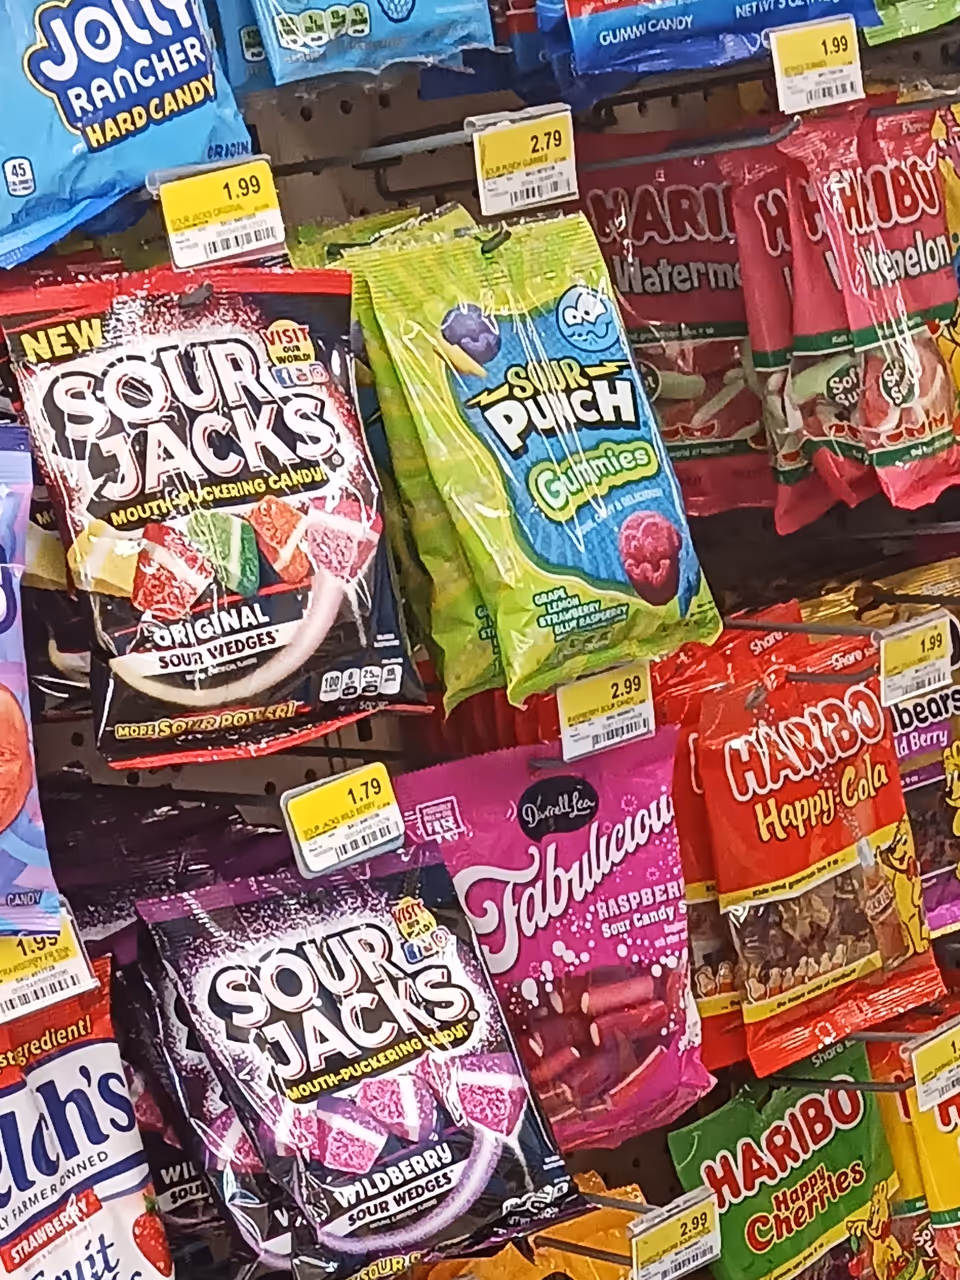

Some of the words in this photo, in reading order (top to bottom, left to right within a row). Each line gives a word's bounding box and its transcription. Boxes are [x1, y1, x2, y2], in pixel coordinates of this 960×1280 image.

[40, 0, 194, 82] JOLLY
[648, 14, 694, 33] CANDY
[821, 34, 849, 56] 1.99
[66, 36, 207, 118] RANCHER
[85, 107, 148, 148] HARD
[149, 73, 216, 120] CANDY
[530, 129, 562, 155] 2.79
[11, 163, 27, 178] 45
[222, 174, 262, 201] 1.99
[21, 318, 104, 363] NEW
[263, 325, 310, 346] VISIT
[53, 341, 271, 441] SOUR
[506, 359, 591, 399] SOUR
[486, 379, 639, 453] PUNCH
[100, 396, 338, 501] JACKS
[537, 448, 650, 511] Gummies
[110, 478, 267, 528] MOUTH-PUCKERING
[534, 587, 567, 605] GRAPE
[538, 601, 601, 628] STRAWBERRY
[546, 595, 579, 613] LEMON
[152, 604, 270, 647] ORIGINAL
[920, 635, 944, 654] 1.99
[157, 649, 205, 670] SOUR
[210, 631, 278, 661] WEDGES
[833, 646, 862, 671] Share
[323, 675, 341, 690] 100
[610, 675, 641, 700] 2.99
[115, 722, 155, 740] MORE
[724, 684, 885, 801] HARIBO
[909, 730, 949, 752] Berry
[346, 778, 382, 806] 1.79
[755, 784, 836, 843] Happy
[839, 754, 890, 809] Cola
[7, 892, 42, 907] CANDY
[601, 919, 631, 938] Sour
[633, 904, 675, 928] Candy
[215, 925, 401, 1030] SOUR
[256, 968, 468, 1081] JACKS
[286, 1039, 422, 1102] MOUTH-PUCKERING
[811, 1040, 844, 1068] Share
[0, 1065, 138, 1198] lch's
[699, 1074, 866, 1216] HARIBO
[10, 1183, 58, 1225] FARMER
[58, 1150, 110, 1193] OWNED
[334, 1142, 452, 1208] WILDBERRY
[773, 1161, 826, 1213] Happy
[347, 1200, 391, 1227] SOUR
[391, 1170, 453, 1212] WEDGES
[745, 1159, 867, 1254] Cherries
[10, 1196, 89, 1266] STRAWBERRY
[680, 1211, 708, 1238] 2.99
